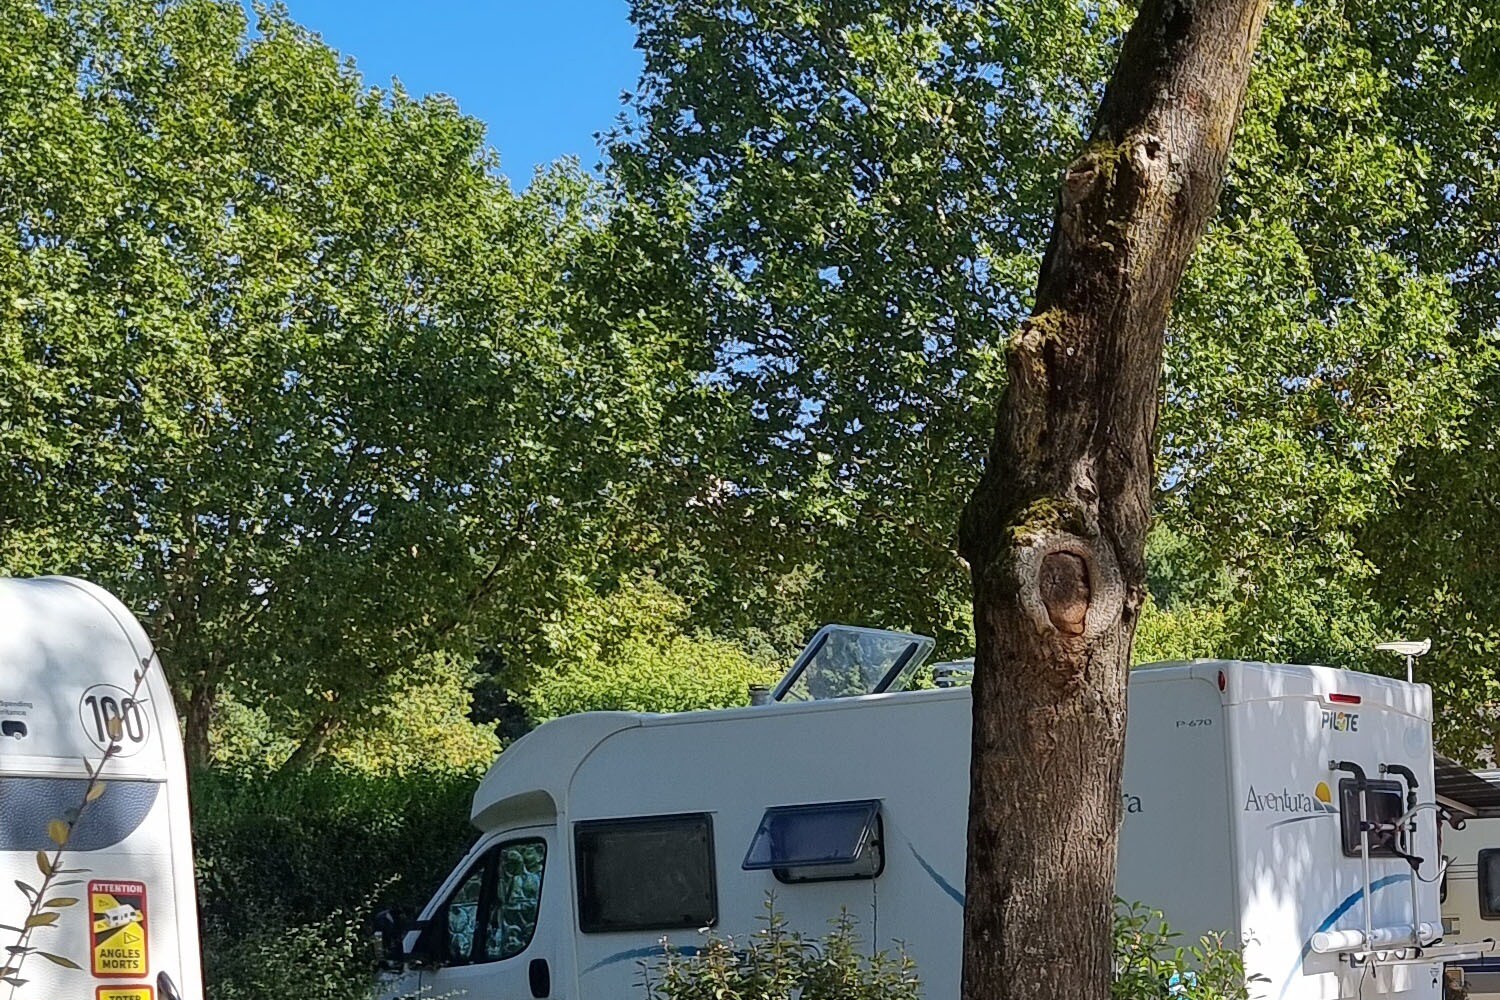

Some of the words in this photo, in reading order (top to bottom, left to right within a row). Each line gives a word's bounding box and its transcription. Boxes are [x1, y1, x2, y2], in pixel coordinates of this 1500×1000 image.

[85, 695, 143, 742] 100
[1244, 784, 1312, 812] Aventura
[92, 883, 142, 893] ATTENTION
[100, 948, 140, 959] ANGLES
[102, 960, 139, 969] MORTS
